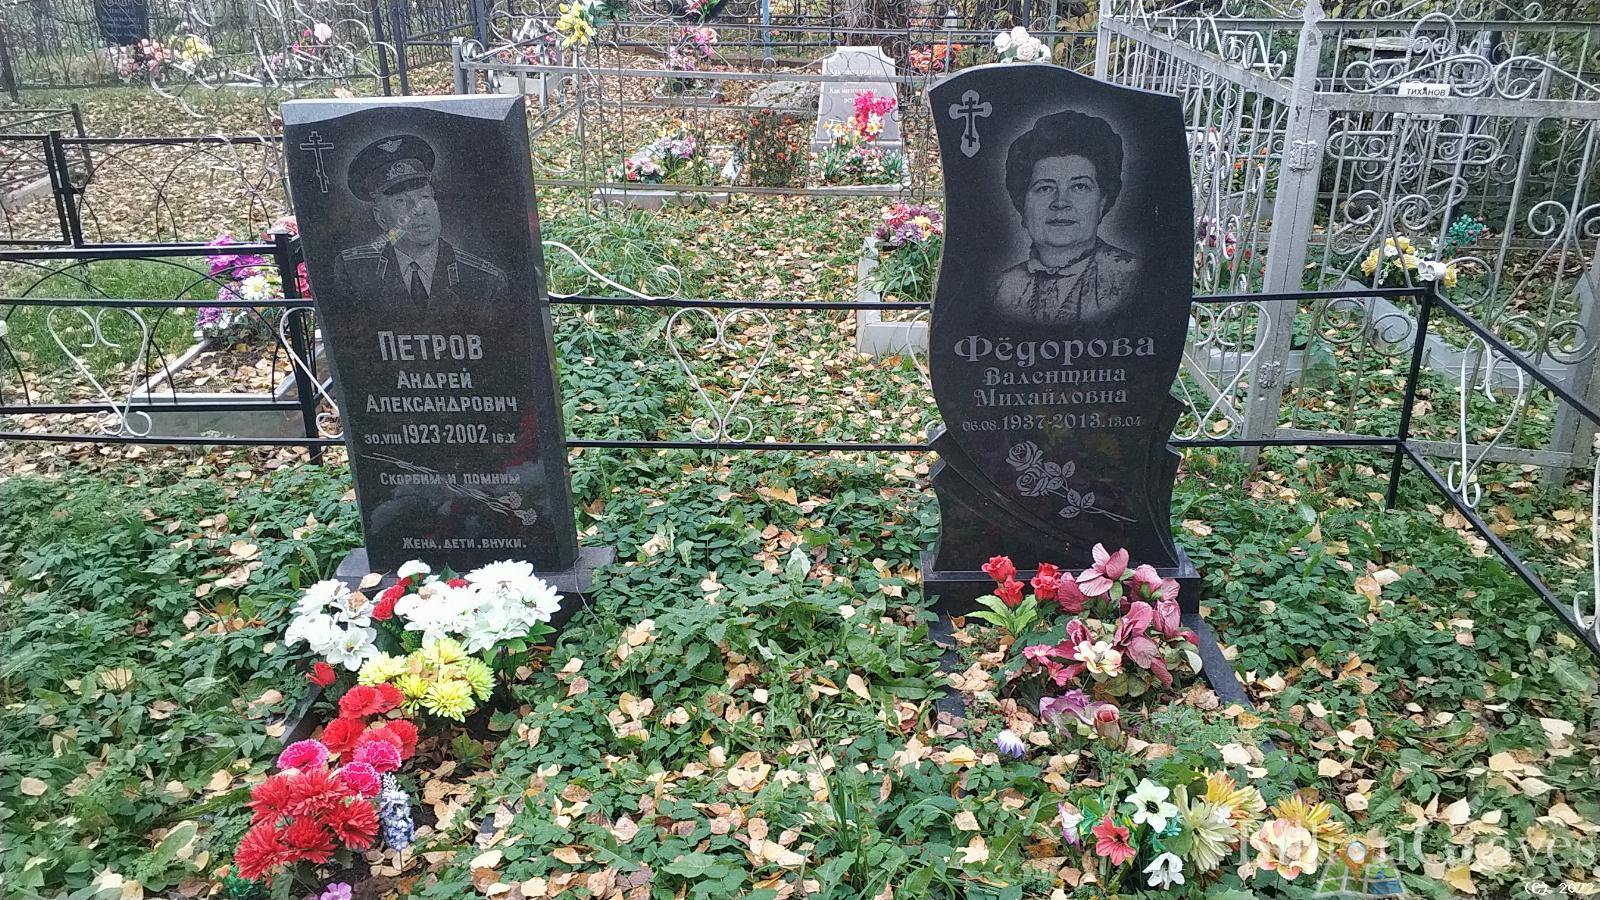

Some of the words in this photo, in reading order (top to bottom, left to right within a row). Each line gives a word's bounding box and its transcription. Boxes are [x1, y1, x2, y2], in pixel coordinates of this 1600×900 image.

[1407, 87, 1446, 97] ТИХАНОВ
[378, 331, 484, 361] ПЕТРОВ
[954, 335, 1157, 368] Фёдорова
[397, 367, 473, 389] АНДРЕЙ
[983, 367, 1127, 387] Валентина
[365, 393, 518, 413] АЛЕКСАНДРОВИЧ
[974, 388, 1128, 407] Михайловна
[380, 472, 442, 485] СКОРБИМ
[463, 472, 521, 485] ПОМНИМ
